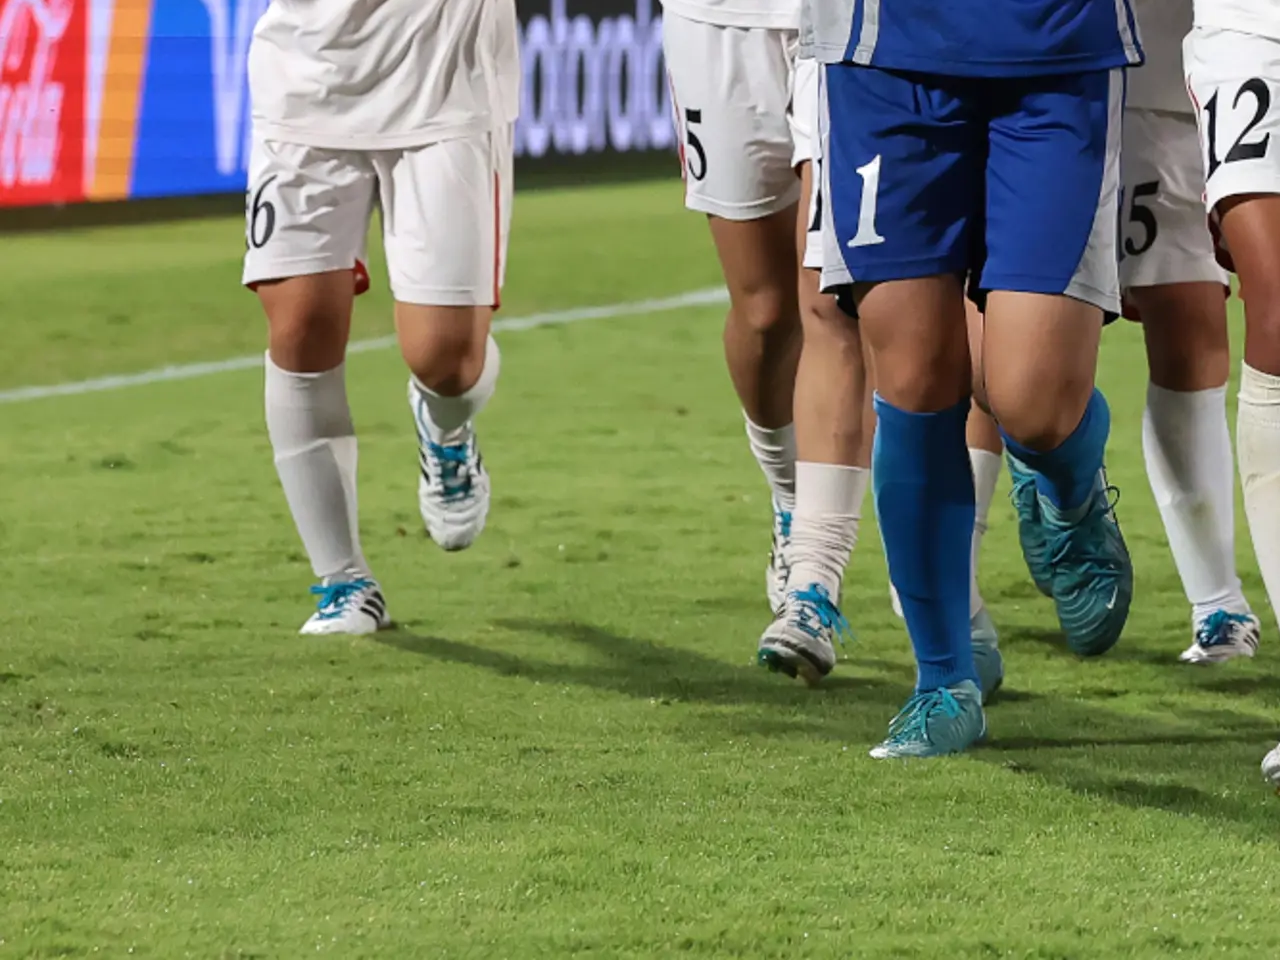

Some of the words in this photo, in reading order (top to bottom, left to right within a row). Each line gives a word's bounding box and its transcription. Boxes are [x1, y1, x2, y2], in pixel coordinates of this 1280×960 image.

[1203, 77, 1270, 182] 12
[246, 174, 276, 248] 6
[847, 154, 885, 247] 1
